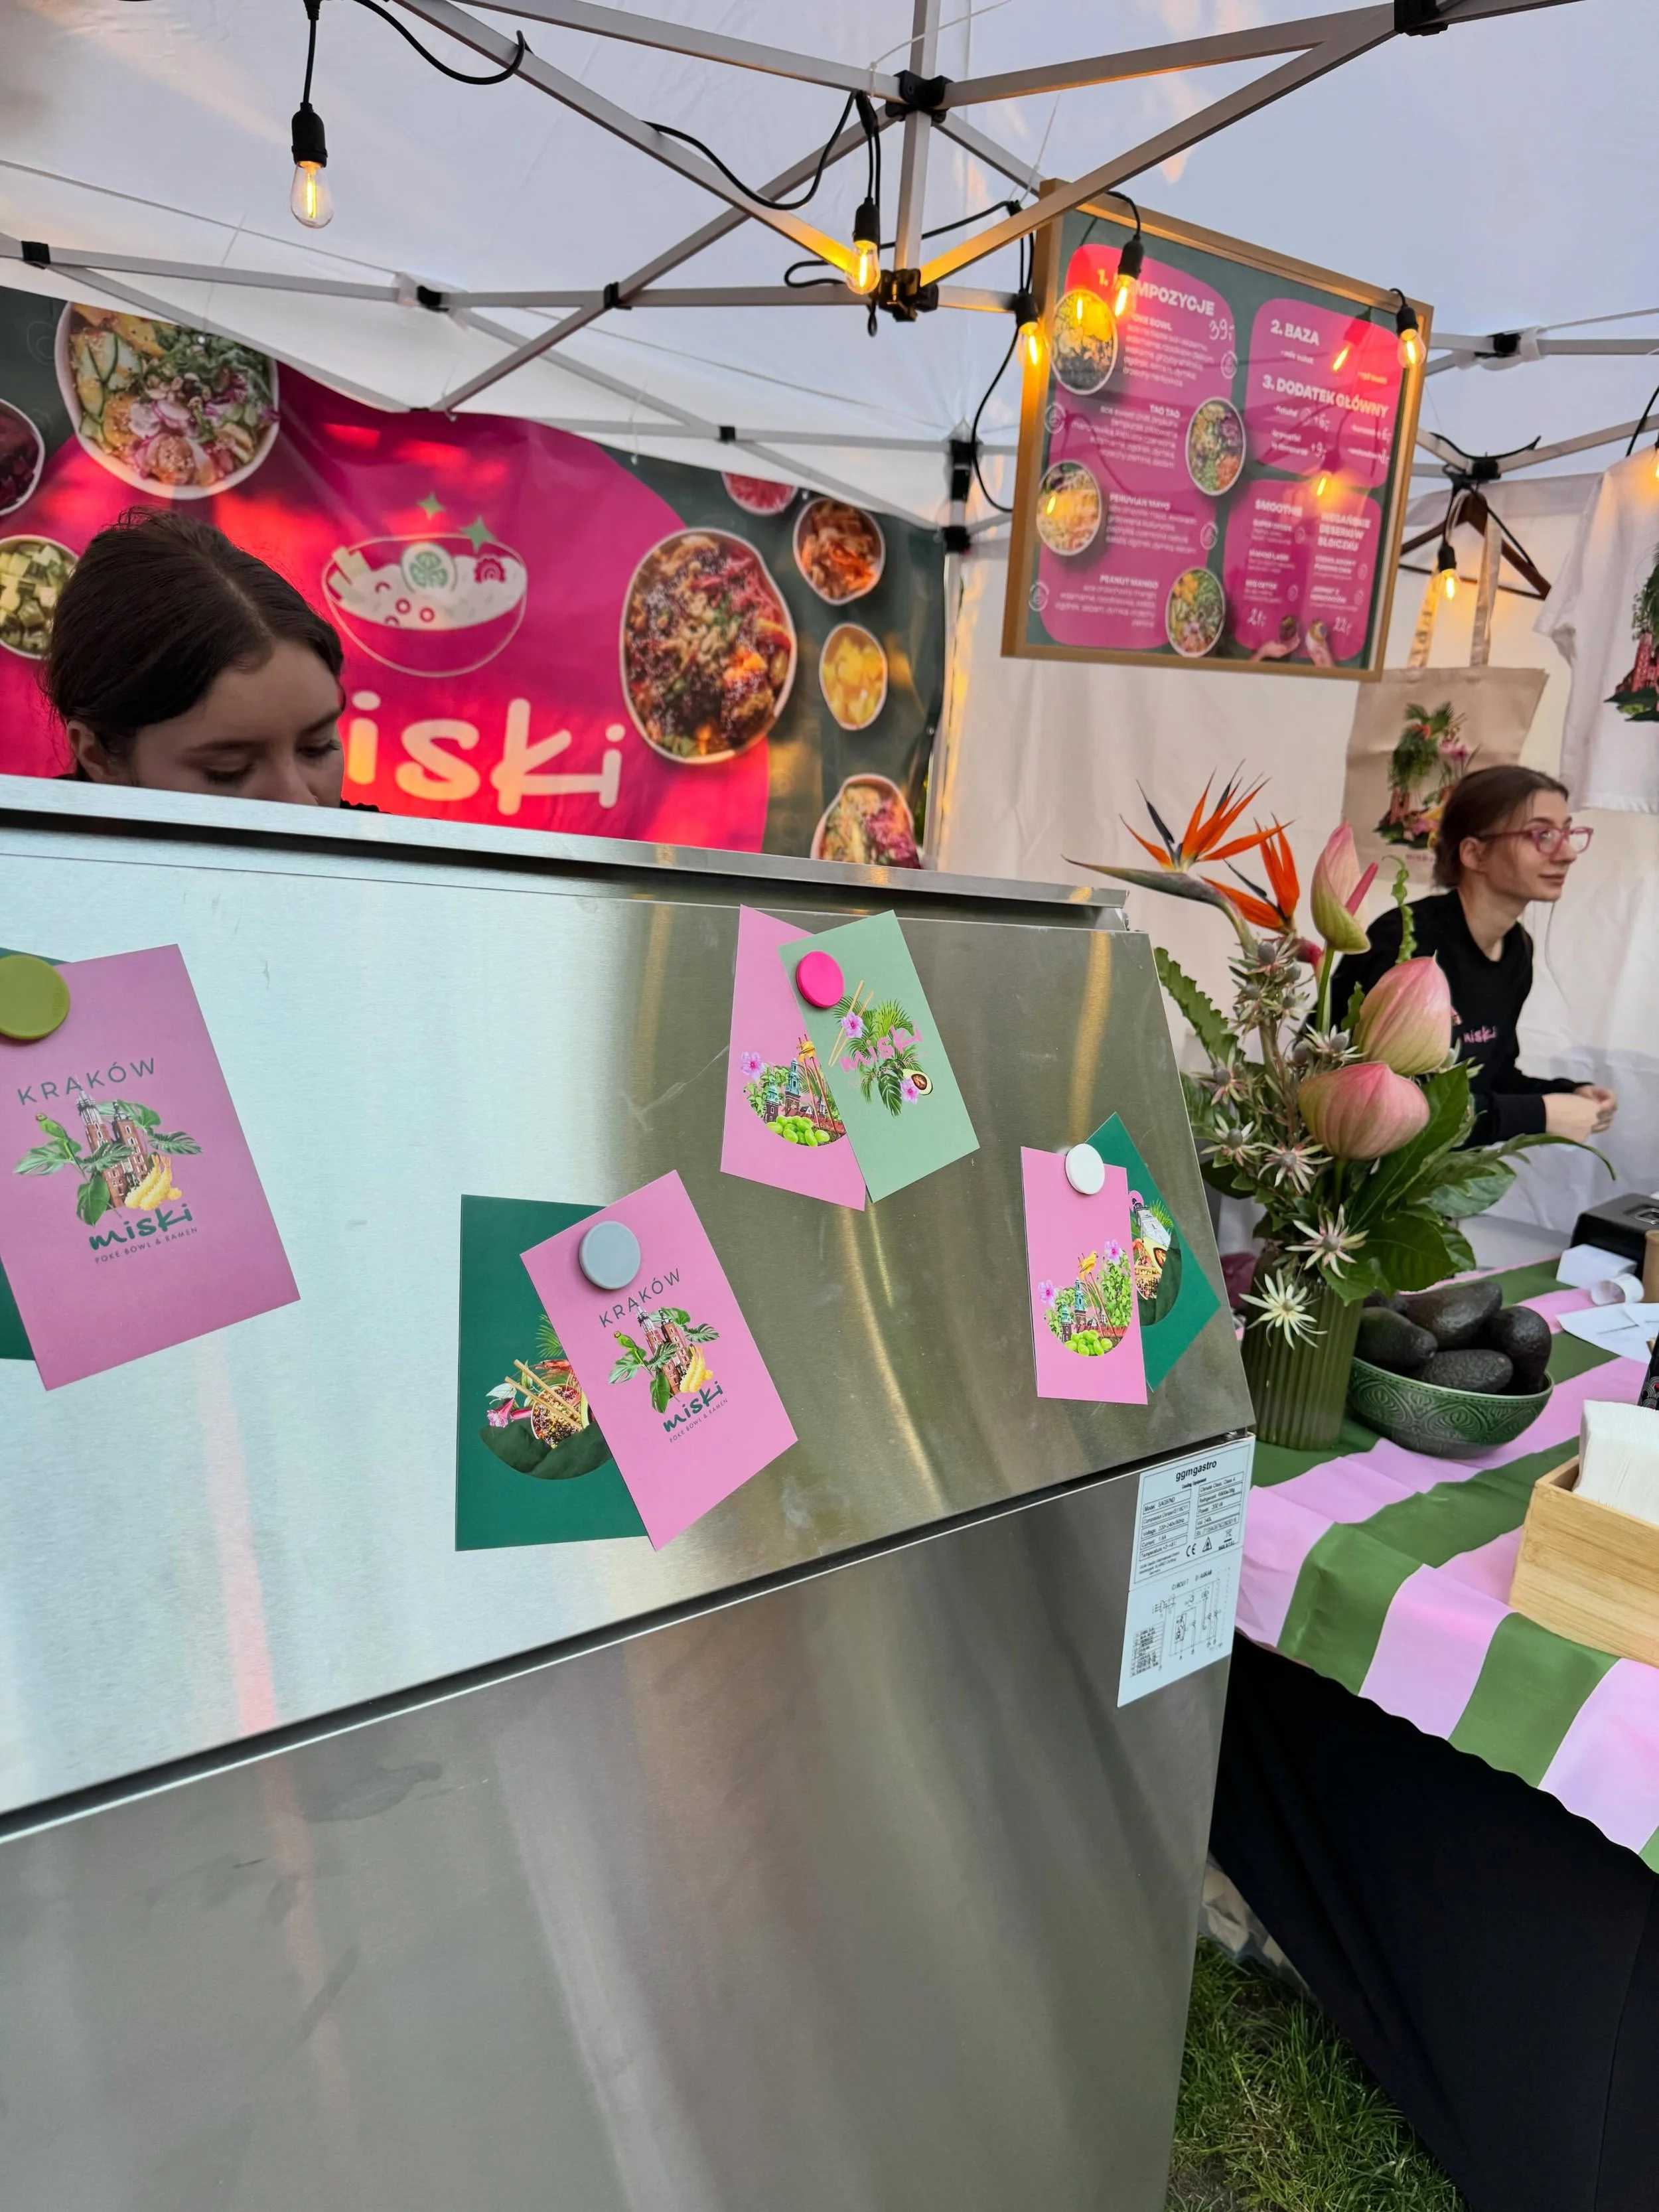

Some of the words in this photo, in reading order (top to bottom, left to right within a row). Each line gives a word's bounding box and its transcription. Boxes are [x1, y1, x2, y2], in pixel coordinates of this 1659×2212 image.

[1097, 268, 1109, 286] 1.
[1113, 273, 1215, 317] MPOZYCJE
[1270, 319, 1283, 335] 2.
[1285, 323, 1319, 346] BAZA
[1262, 374, 1275, 390] 3.
[1276, 378, 1335, 406] DODATEK
[1336, 392, 1390, 418] GŁÓWNY
[1255, 498, 1303, 518] SMOOTHIE
[348, 690, 626, 815] iski
[839, 1021, 923, 1073] miski
[17, 1057, 155, 1106] KRAKÓW
[89, 1203, 193, 1250] miski
[94, 1250, 121, 1264] POKE
[124, 1242, 152, 1256] BOWL
[165, 1227, 198, 1243] RAMEN
[599, 1268, 681, 1328] KRAKÓW
[662, 1380, 723, 1433] miski
[669, 1432, 685, 1443] POKE
[685, 1418, 702, 1432] BOWL
[708, 1398, 728, 1414] RAMEN
[1175, 1460, 1217, 1482] ggmgastro
